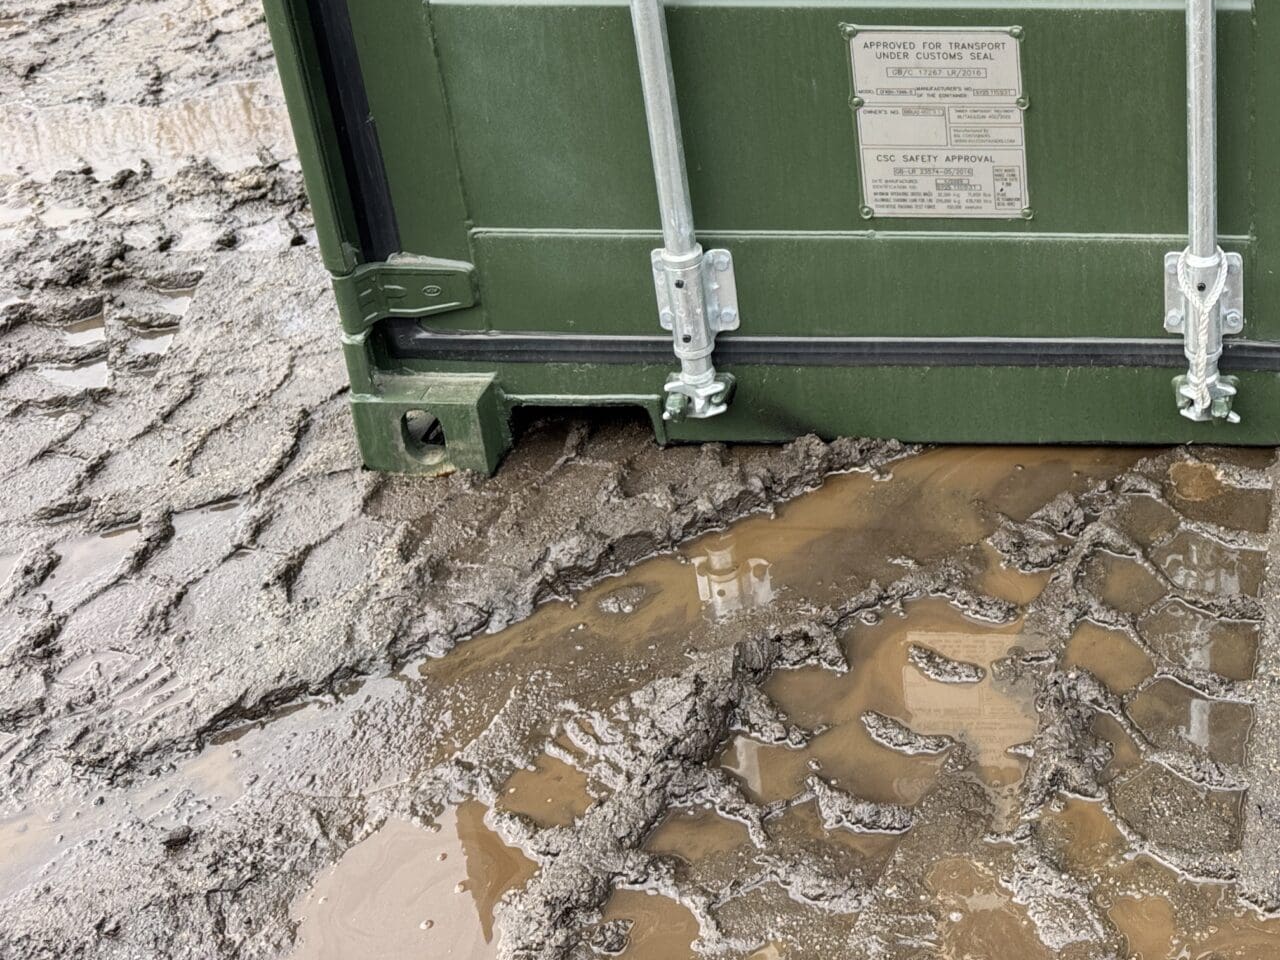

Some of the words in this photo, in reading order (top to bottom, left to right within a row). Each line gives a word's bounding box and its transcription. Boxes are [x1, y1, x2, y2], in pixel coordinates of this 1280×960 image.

[863, 41, 916, 50] APPROVED
[922, 41, 942, 50] FOR
[949, 42, 1006, 51] TRANSPORT
[875, 51, 909, 60] UNDER
[915, 51, 964, 60] CUSTOMS
[970, 52, 995, 61] SEAL
[876, 154, 896, 162] CSC
[902, 154, 938, 162] SAFETY
[945, 155, 996, 163] APPROVAL
